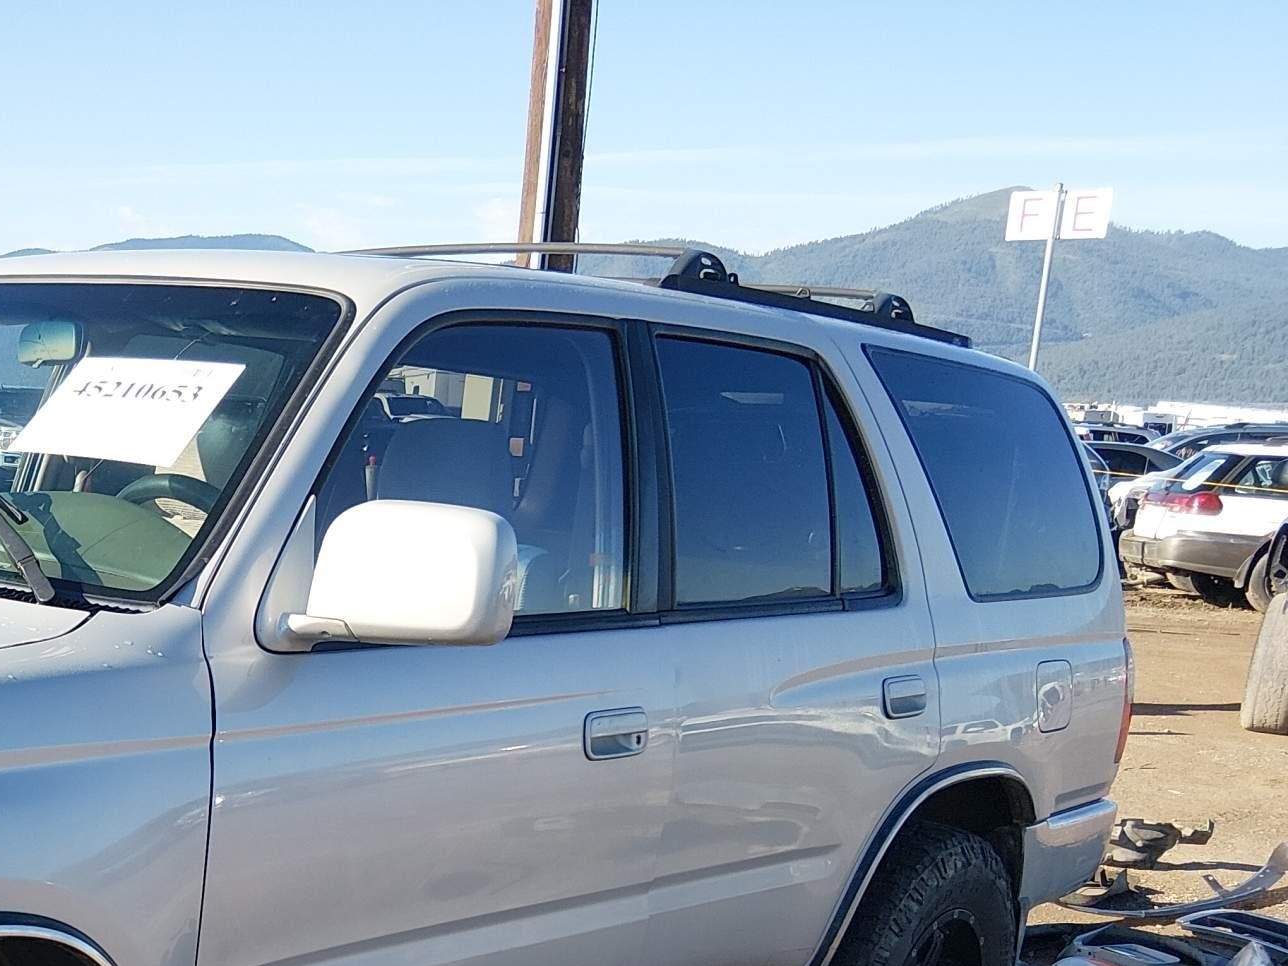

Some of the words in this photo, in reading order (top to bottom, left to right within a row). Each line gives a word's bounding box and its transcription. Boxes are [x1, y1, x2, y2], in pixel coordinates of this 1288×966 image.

[1020, 197, 1043, 233] F
[1072, 195, 1099, 231] E
[73, 380, 204, 403] 45210653
